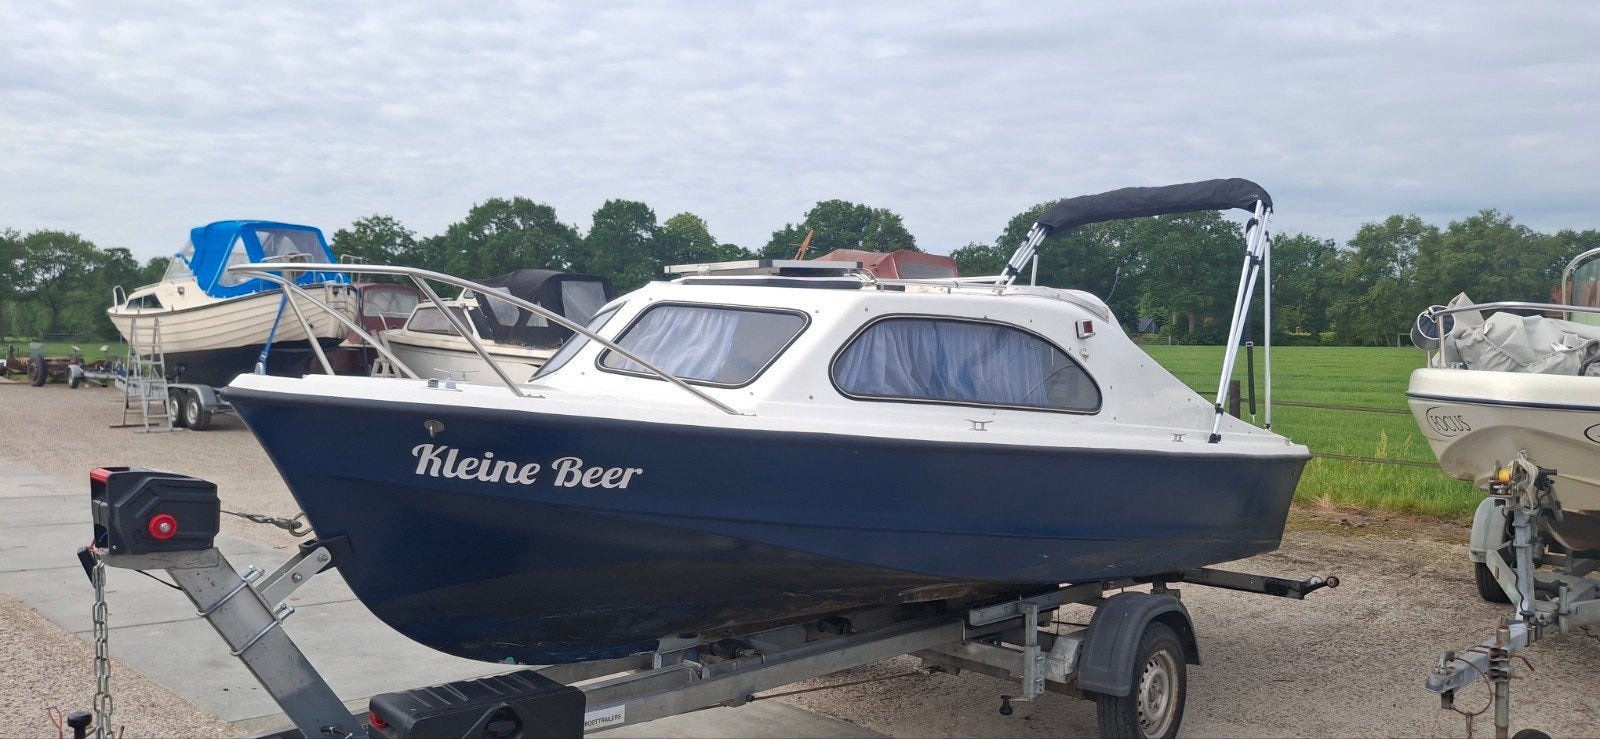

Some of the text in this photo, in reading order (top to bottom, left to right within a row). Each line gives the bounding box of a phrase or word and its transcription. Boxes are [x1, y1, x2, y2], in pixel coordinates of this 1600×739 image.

[1430, 415, 1471, 432] FOCUS
[411, 443, 644, 489] Kleine Beer
